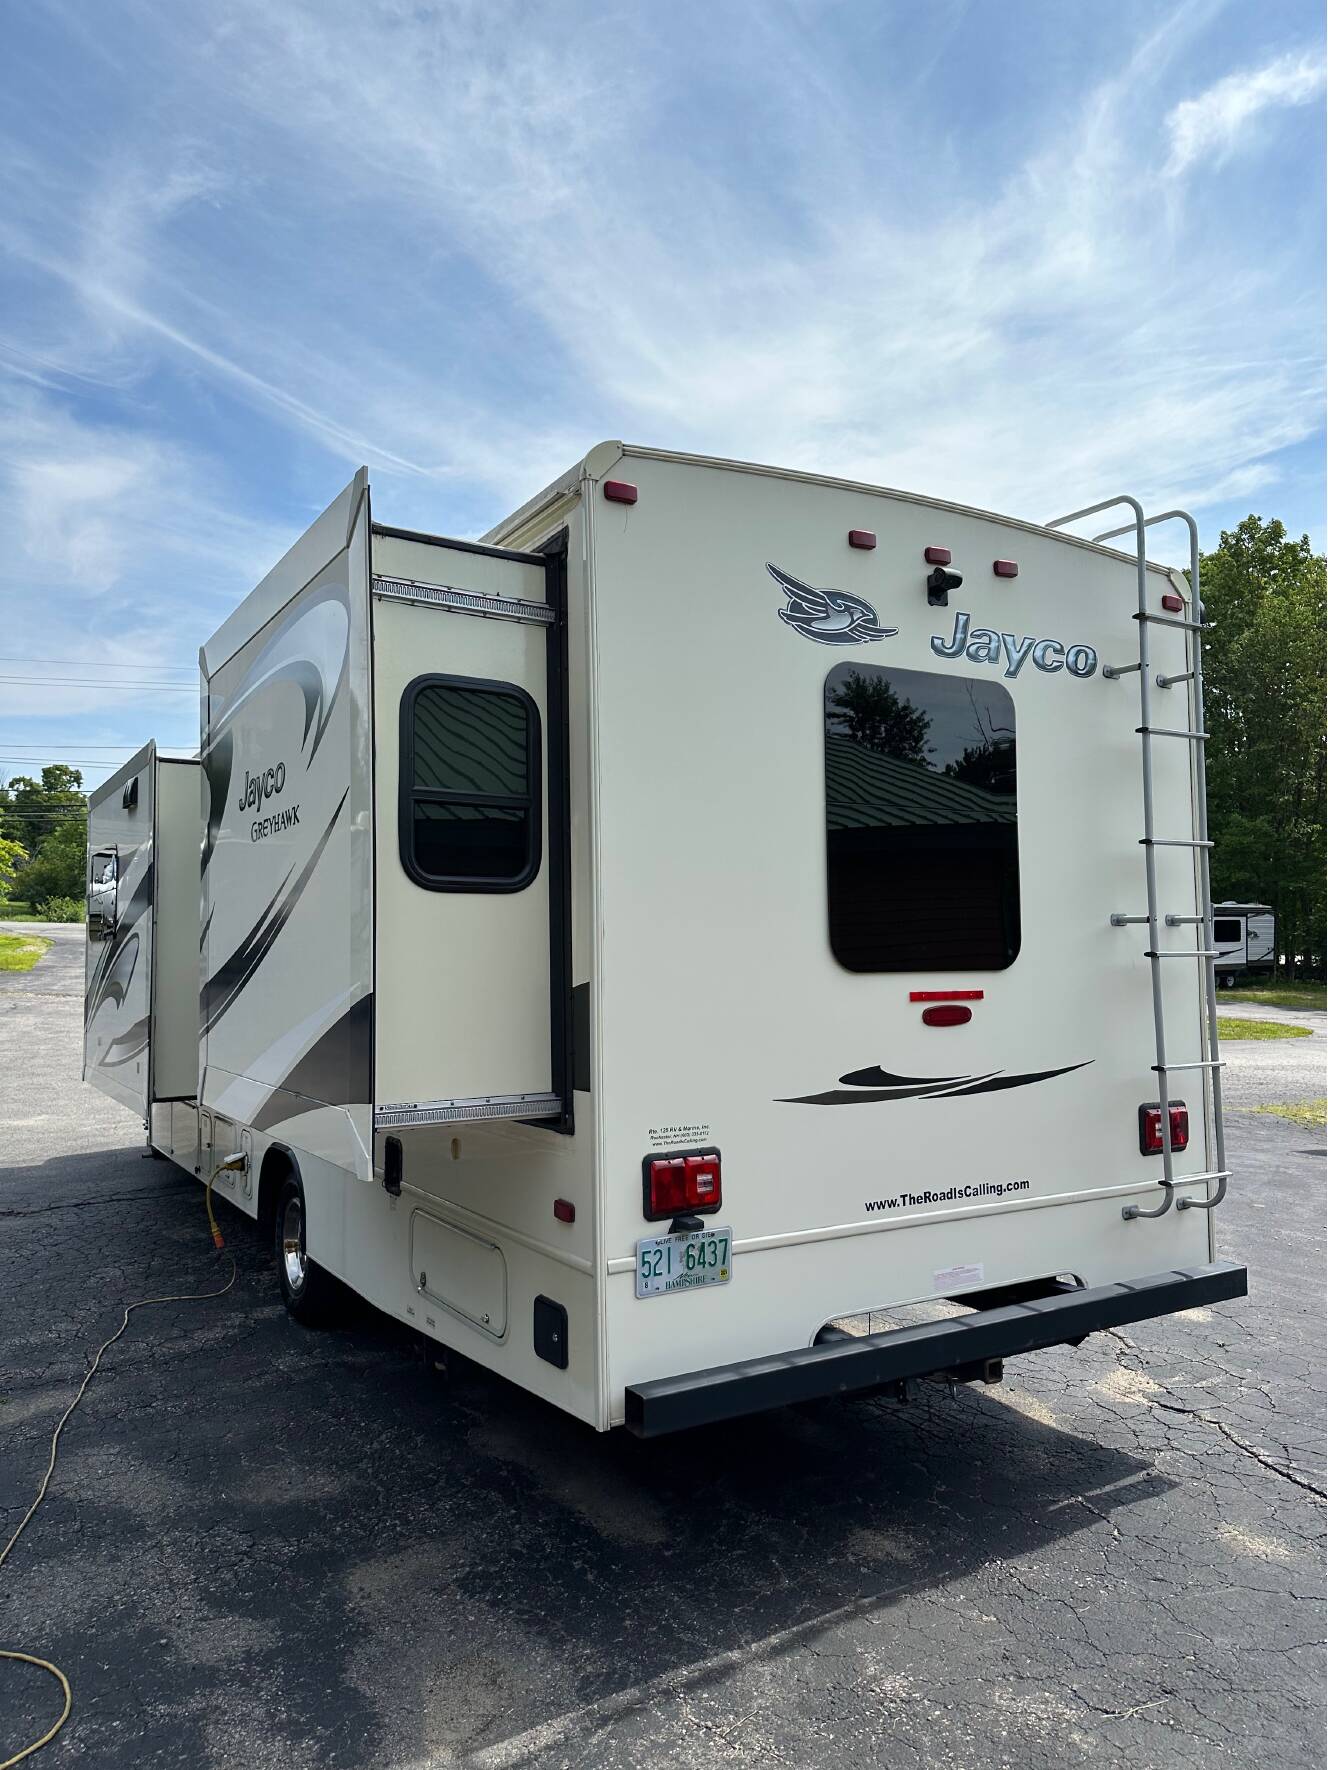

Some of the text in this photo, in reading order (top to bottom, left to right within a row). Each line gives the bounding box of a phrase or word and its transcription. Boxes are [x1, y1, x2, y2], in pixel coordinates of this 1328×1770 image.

[930, 611, 1098, 679] Jayco
[239, 762, 286, 813] Jayco
[251, 804, 300, 842] GREYHAWK
[865, 1180, 1030, 1212] www.TheRoadIsCalling.com
[675, 1234, 689, 1242] FREE
[641, 1238, 729, 1279] 521 6437
[644, 1281, 649, 1289] 8
